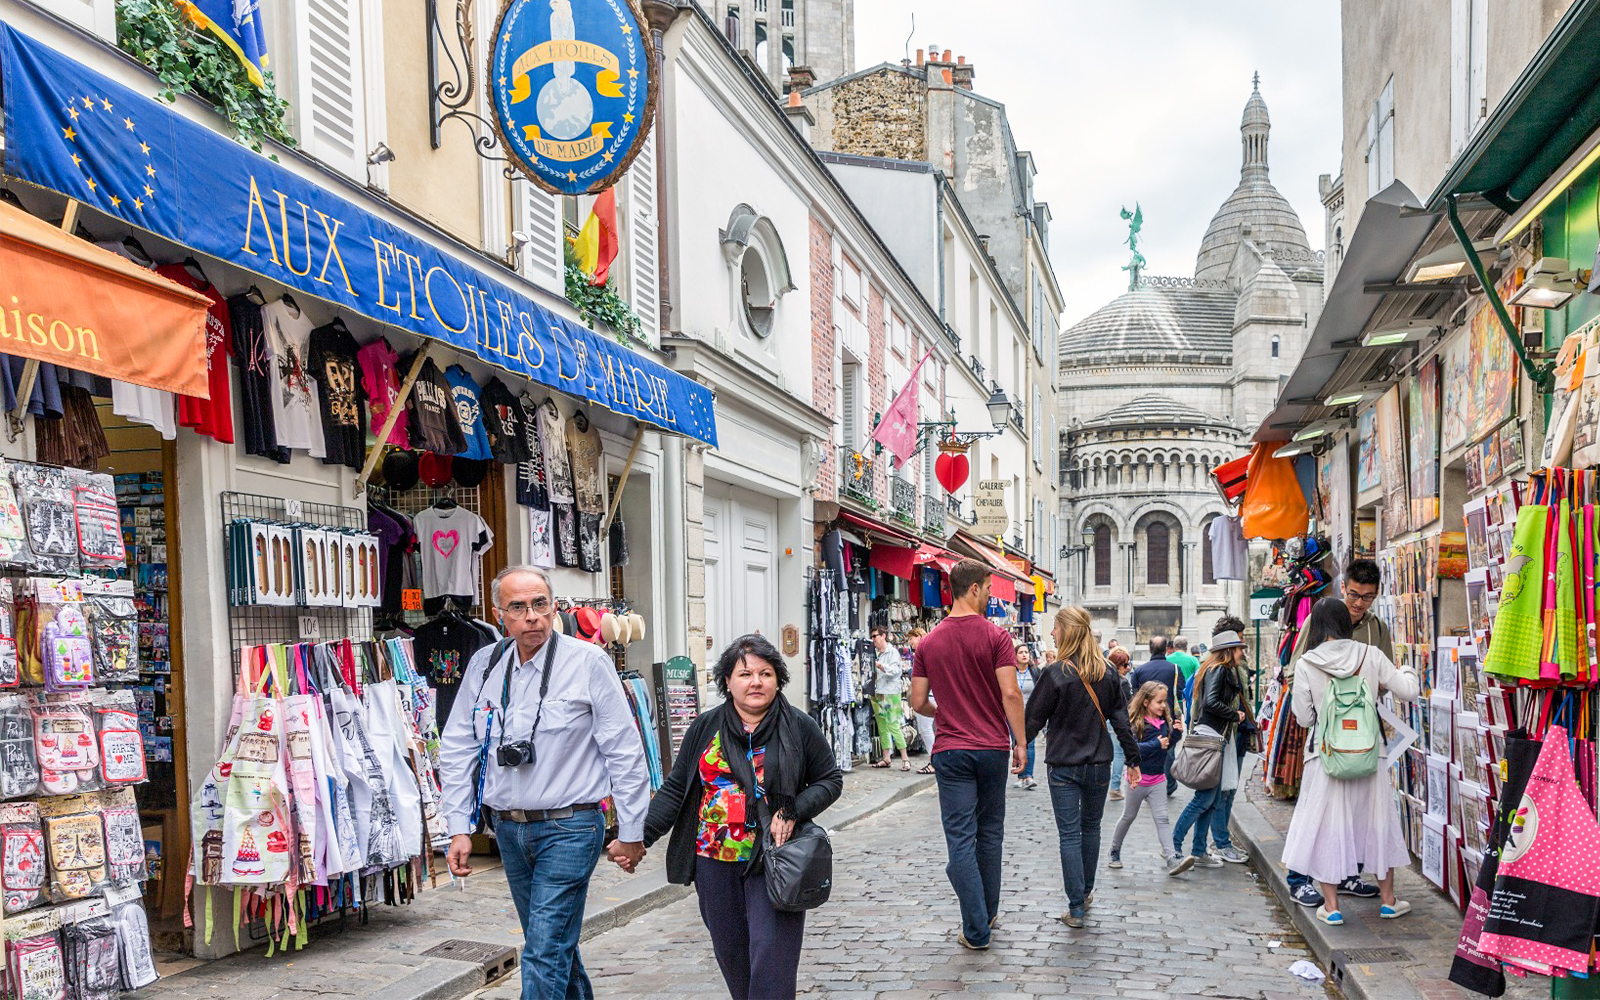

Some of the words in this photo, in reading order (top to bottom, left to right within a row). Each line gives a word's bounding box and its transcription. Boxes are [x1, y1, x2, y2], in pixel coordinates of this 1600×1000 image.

[518, 47, 542, 74] AUX
[549, 43, 611, 65] ETOILES
[537, 141, 552, 156] DE
[557, 139, 599, 158] MARIE
[241, 176, 359, 296] AUX
[370, 235, 544, 369] ETOILES
[551, 326, 596, 391] DE
[598, 350, 677, 423] MARIE
[979, 482, 1004, 490] GALERIE
[976, 498, 1003, 507] CHEVALIER
[303, 617, 317, 635] 10€
[666, 669, 691, 679] MUSIC
[656, 686, 666, 727] MUSIC
